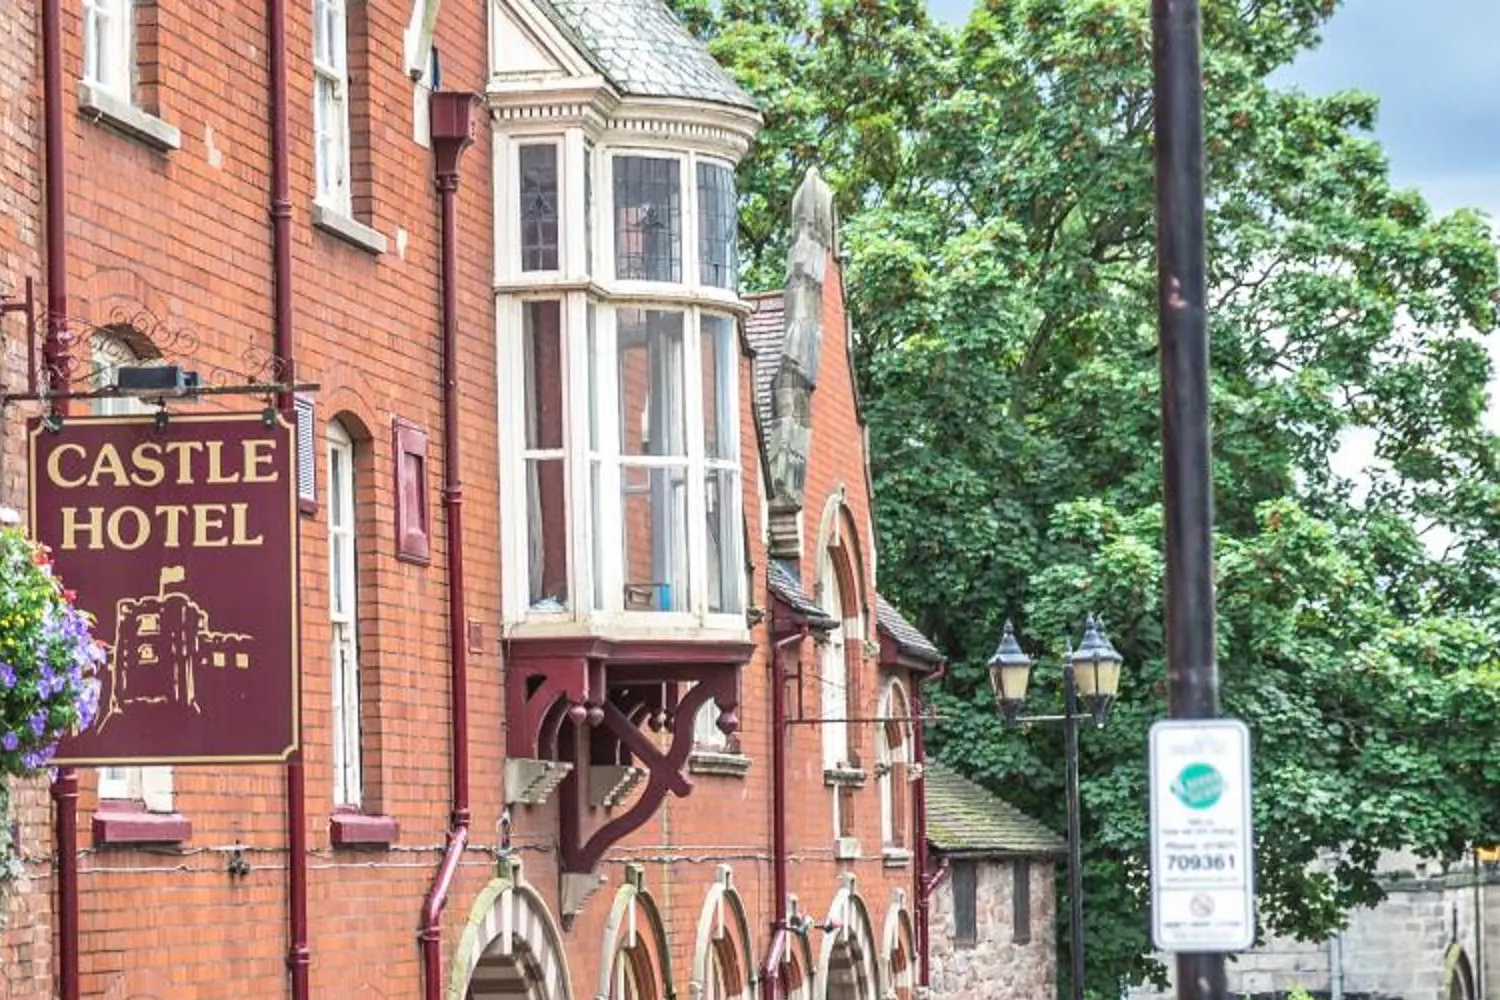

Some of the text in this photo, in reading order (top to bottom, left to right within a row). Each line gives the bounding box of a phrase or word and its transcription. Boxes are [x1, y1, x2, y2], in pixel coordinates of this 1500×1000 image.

[47, 439, 279, 488] CASTLE
[60, 503, 263, 550] HOTEL
[1166, 853, 1235, 872] 709361
